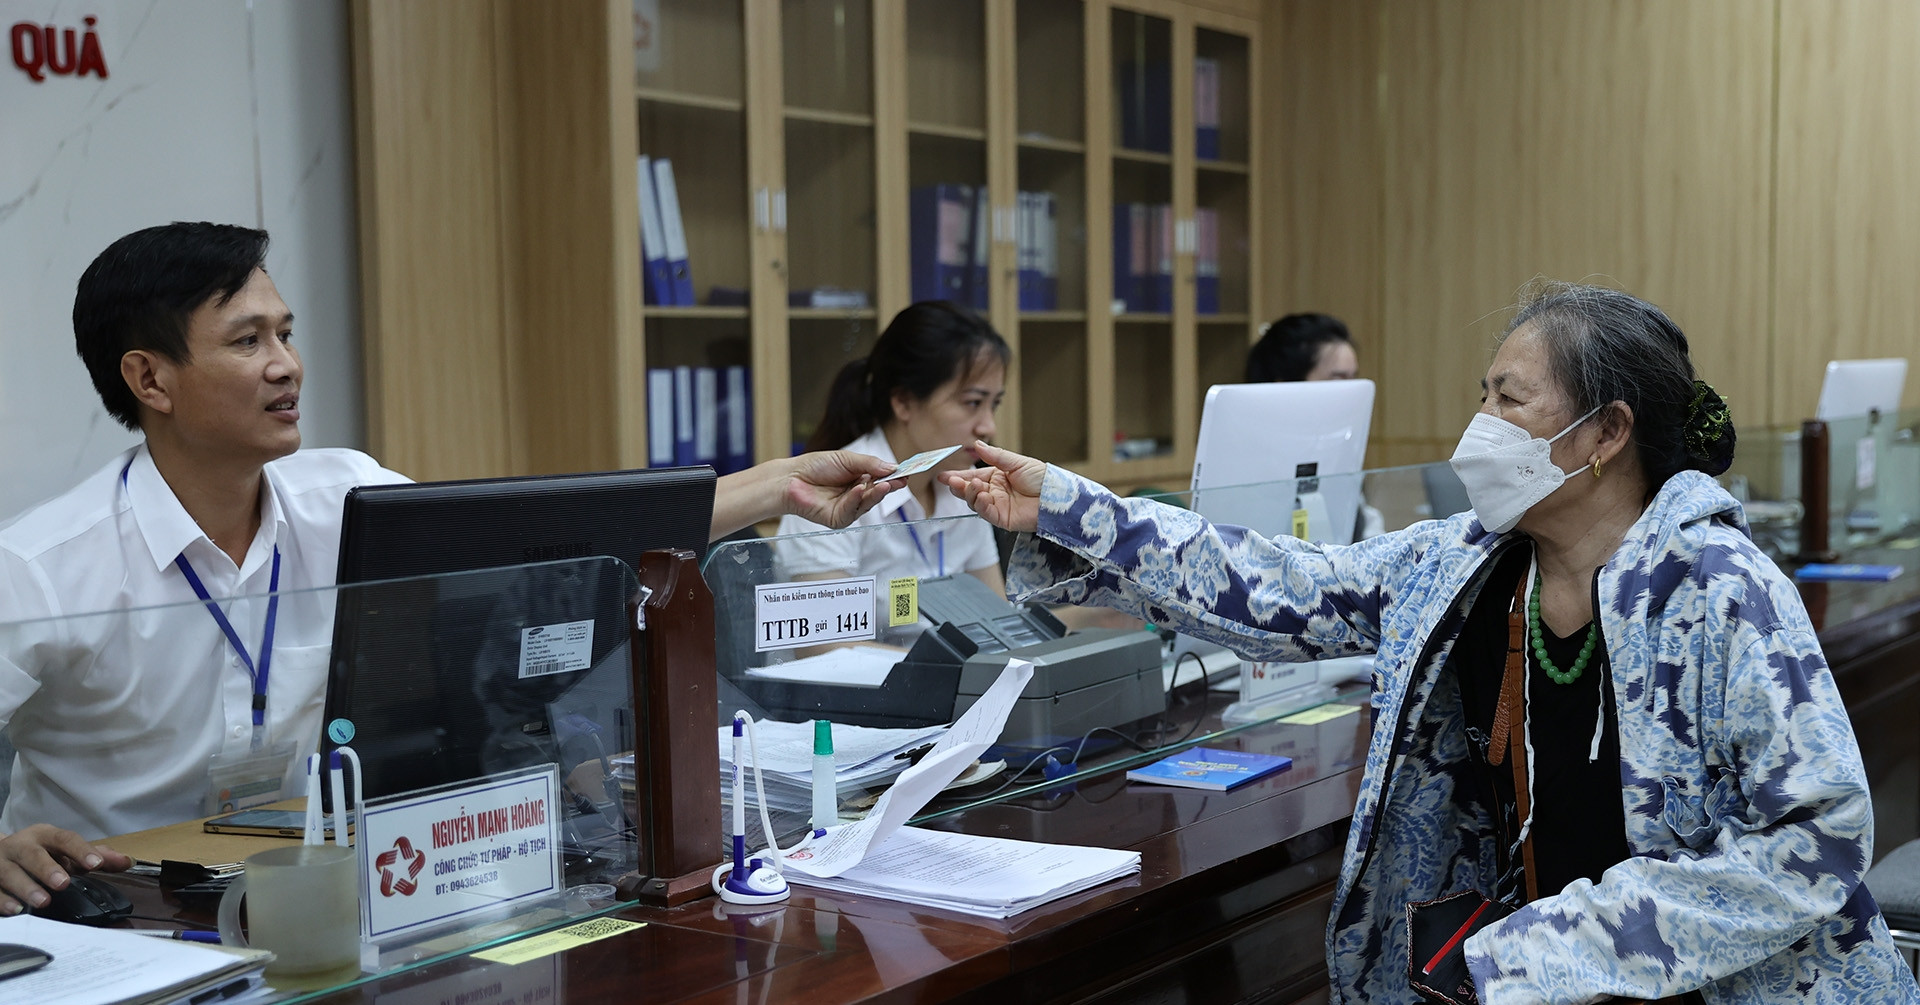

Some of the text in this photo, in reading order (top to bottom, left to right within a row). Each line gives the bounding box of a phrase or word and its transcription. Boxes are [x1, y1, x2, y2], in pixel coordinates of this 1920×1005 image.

[11, 16, 110, 83] QUẢ
[782, 592, 791, 601] tin
[808, 591, 817, 600] tra
[818, 589, 835, 600] thông
[836, 588, 844, 598] tin
[845, 586, 858, 596] thuê
[858, 586, 870, 595] bao
[762, 618, 809, 641] TTTB
[836, 611, 868, 633] 1414
[432, 797, 545, 849] NGUYỄN MẠNH HOÀNG
[434, 858, 456, 876] CÔNG
[458, 853, 478, 871] CHỨC
[492, 845, 512, 862] PHÁP
[530, 837, 546, 854] TỊCH
[436, 871, 498, 896] ĐT: 0943624538
